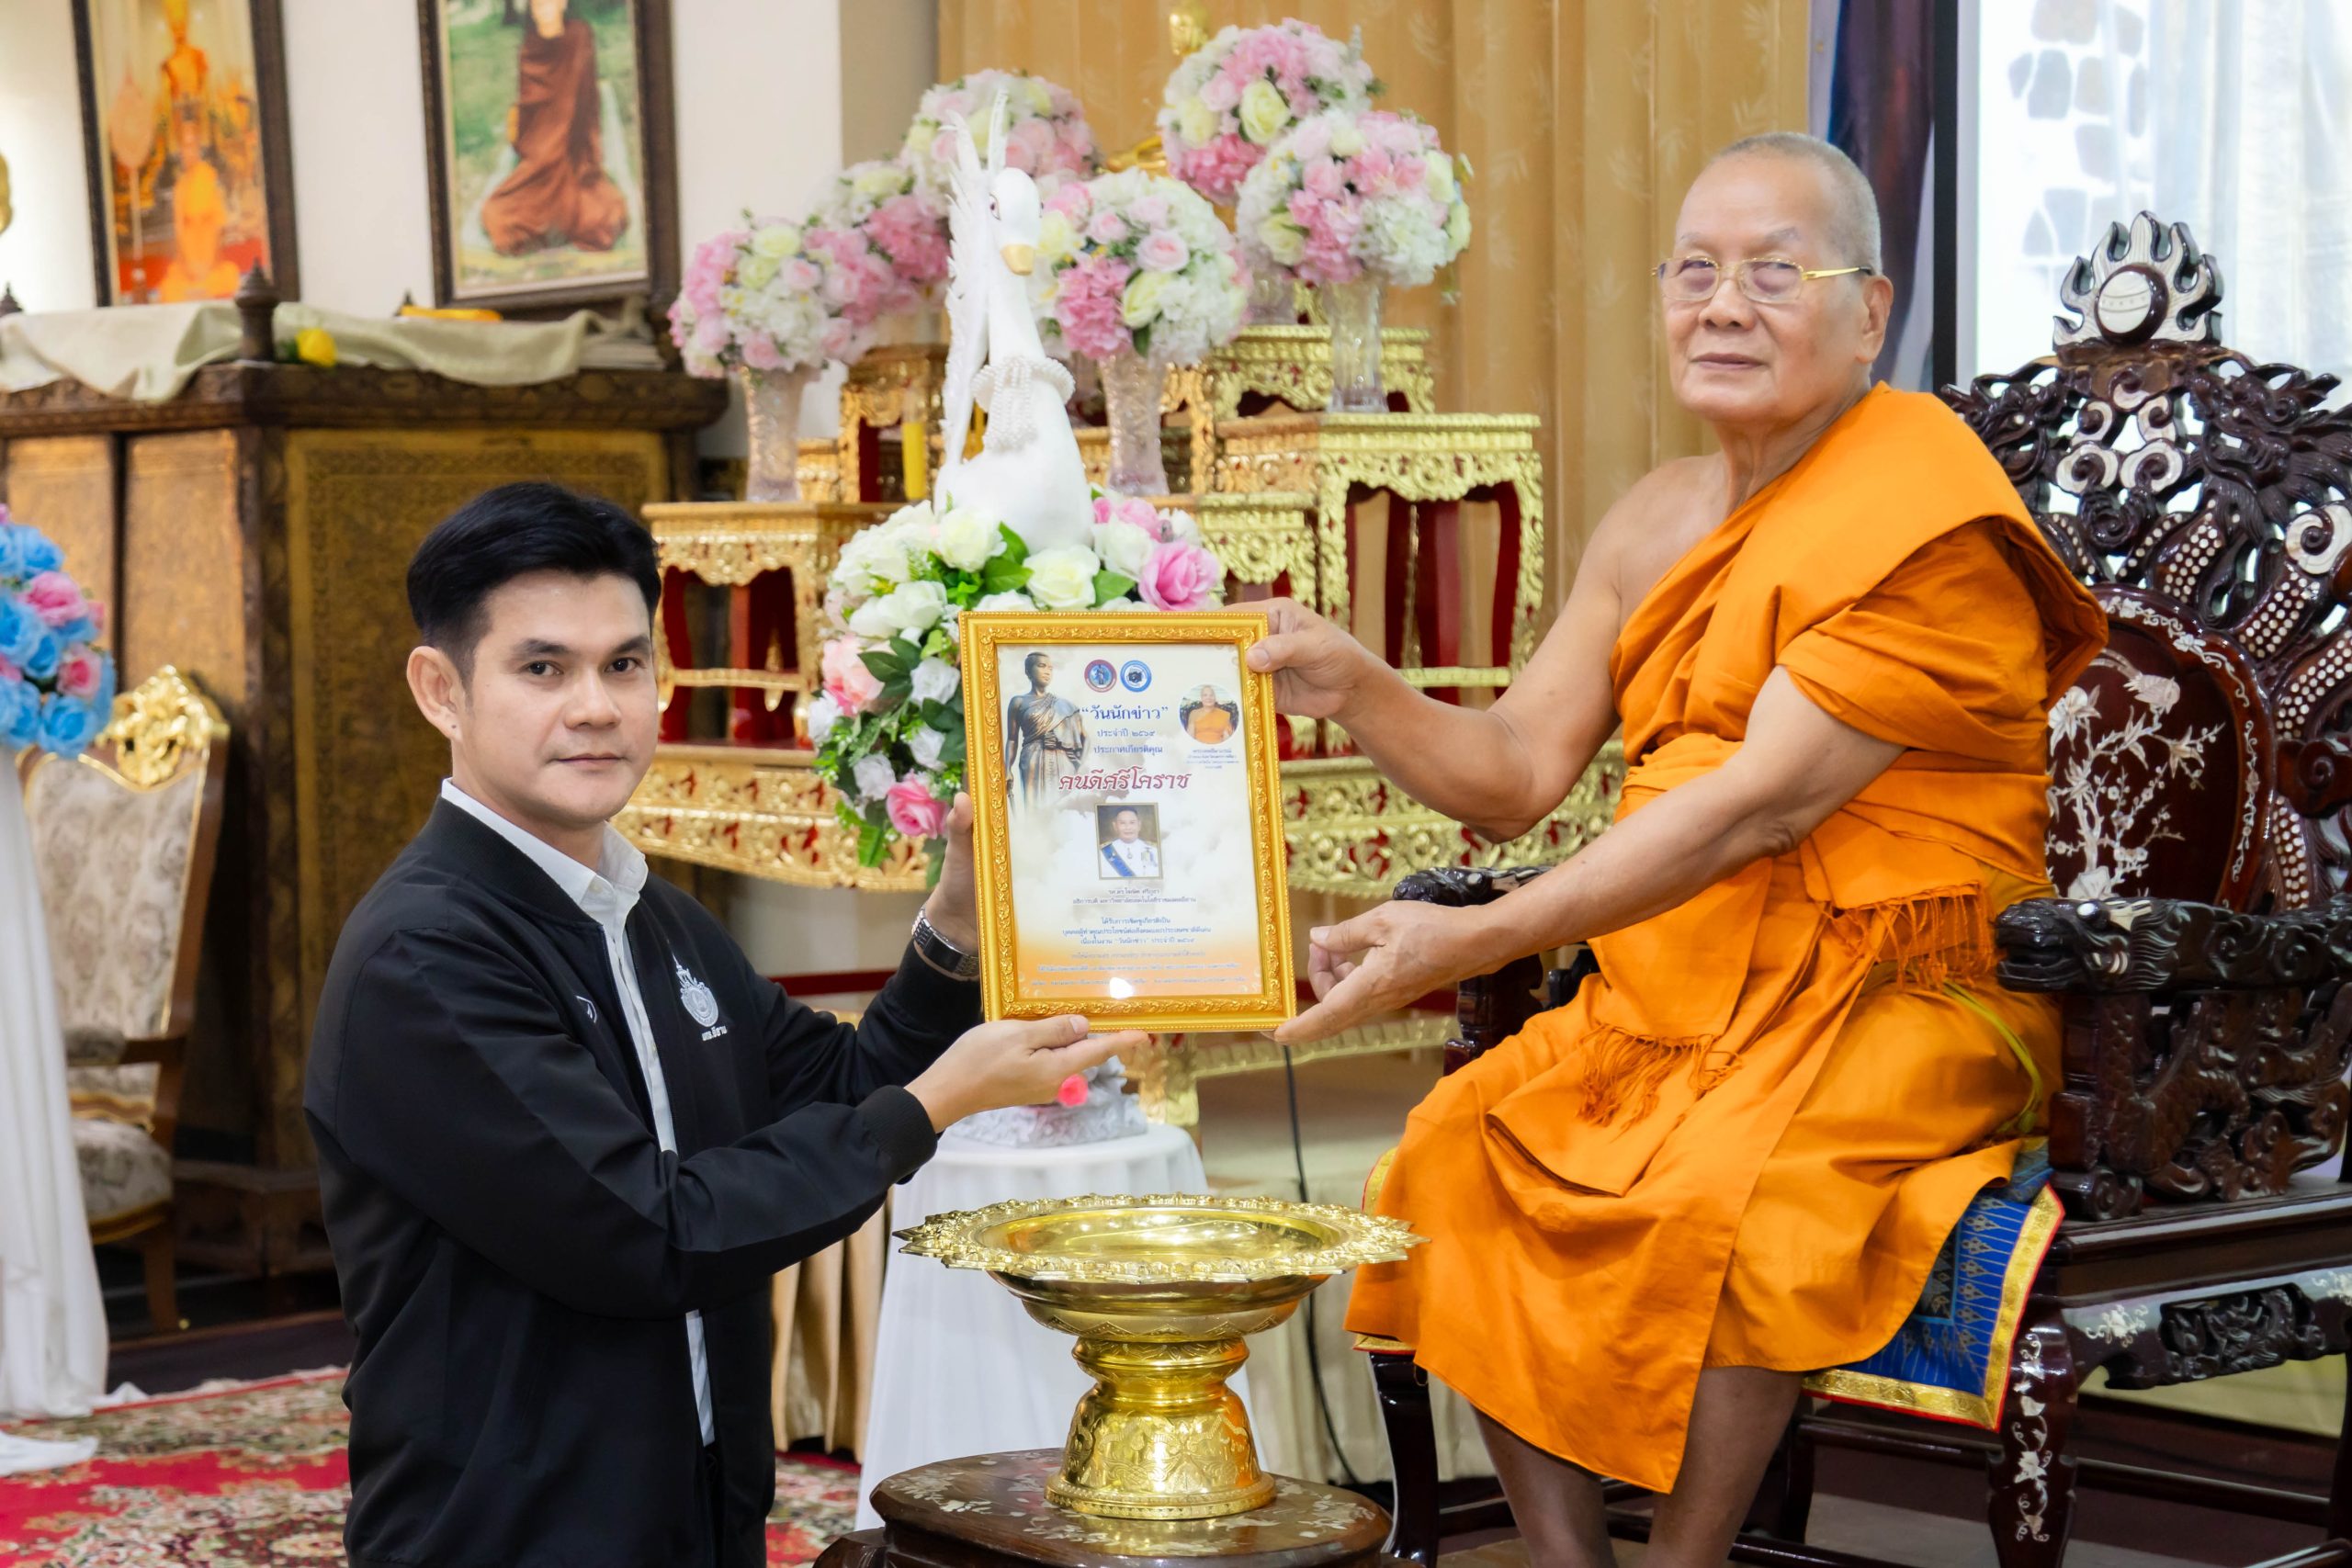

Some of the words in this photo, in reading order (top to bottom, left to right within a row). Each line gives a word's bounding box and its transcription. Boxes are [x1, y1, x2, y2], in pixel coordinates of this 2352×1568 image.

[1097, 728, 1128, 738] ประจำปี
[1093, 744, 1163, 756] ประกาศเกียรติคุณ
[1058, 765, 1193, 790] คนดีศรีโคราช
